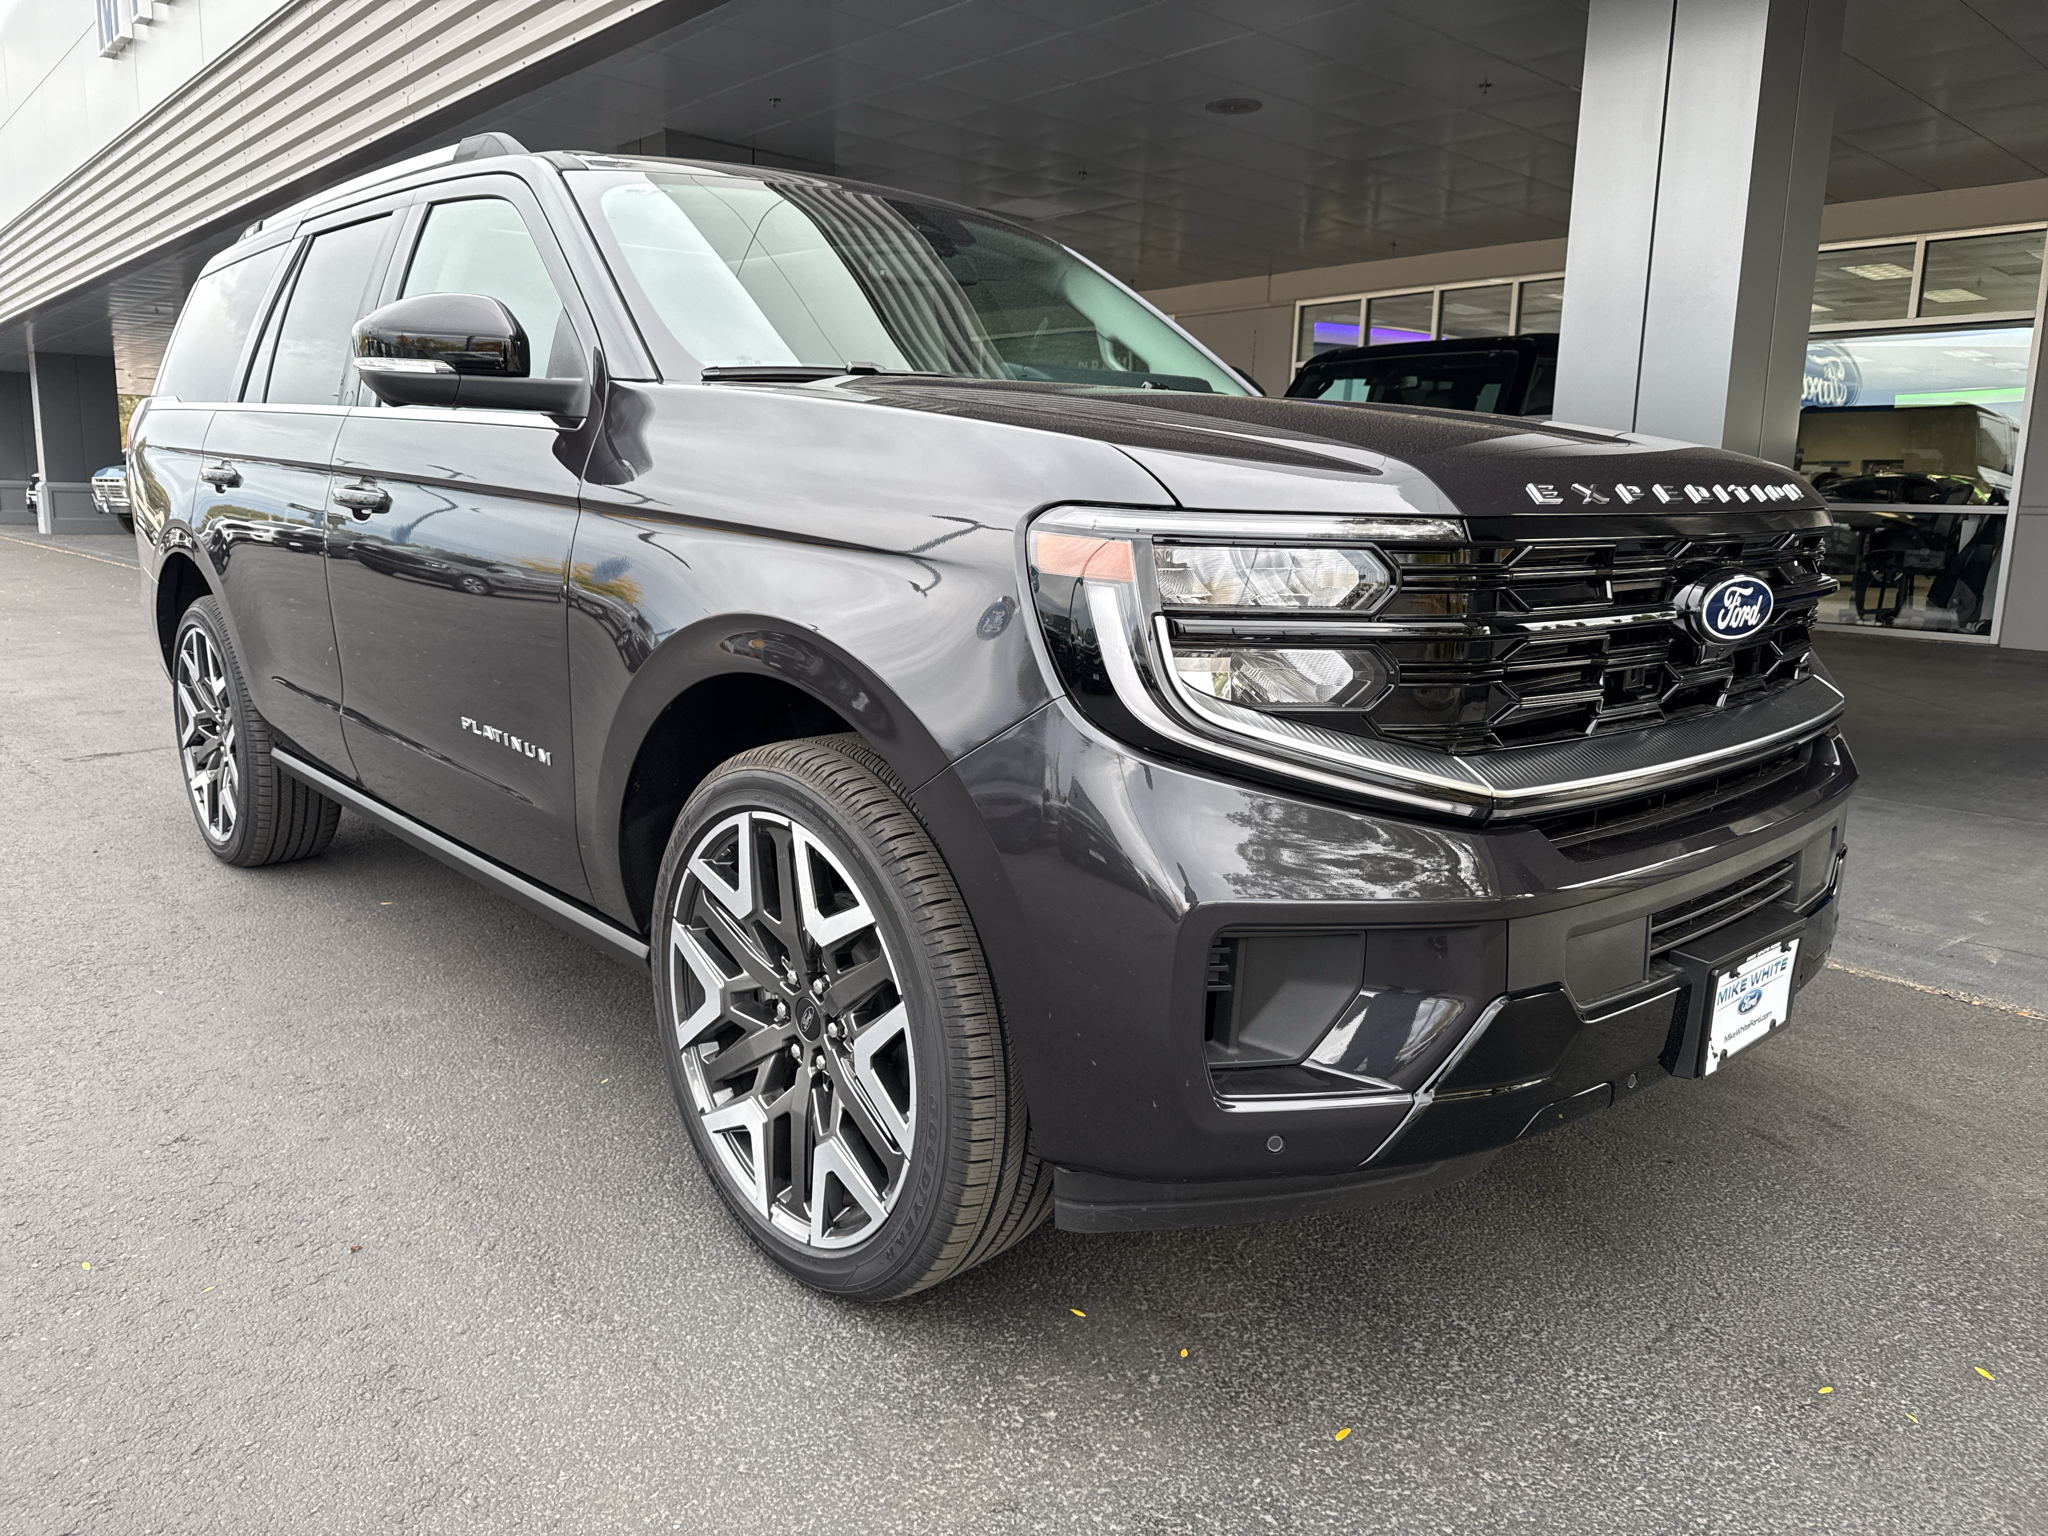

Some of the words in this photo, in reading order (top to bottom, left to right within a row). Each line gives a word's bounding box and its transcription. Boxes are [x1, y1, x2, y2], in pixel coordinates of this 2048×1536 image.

[1525, 481, 1806, 506] EXPEDITION
[1716, 585, 1764, 631] Ford
[460, 716, 553, 767] PLATINUM
[1716, 977, 1748, 1006] MIKE
[1750, 957, 1789, 987] WHITE
[884, 1093, 939, 1264] GOODYEAR
